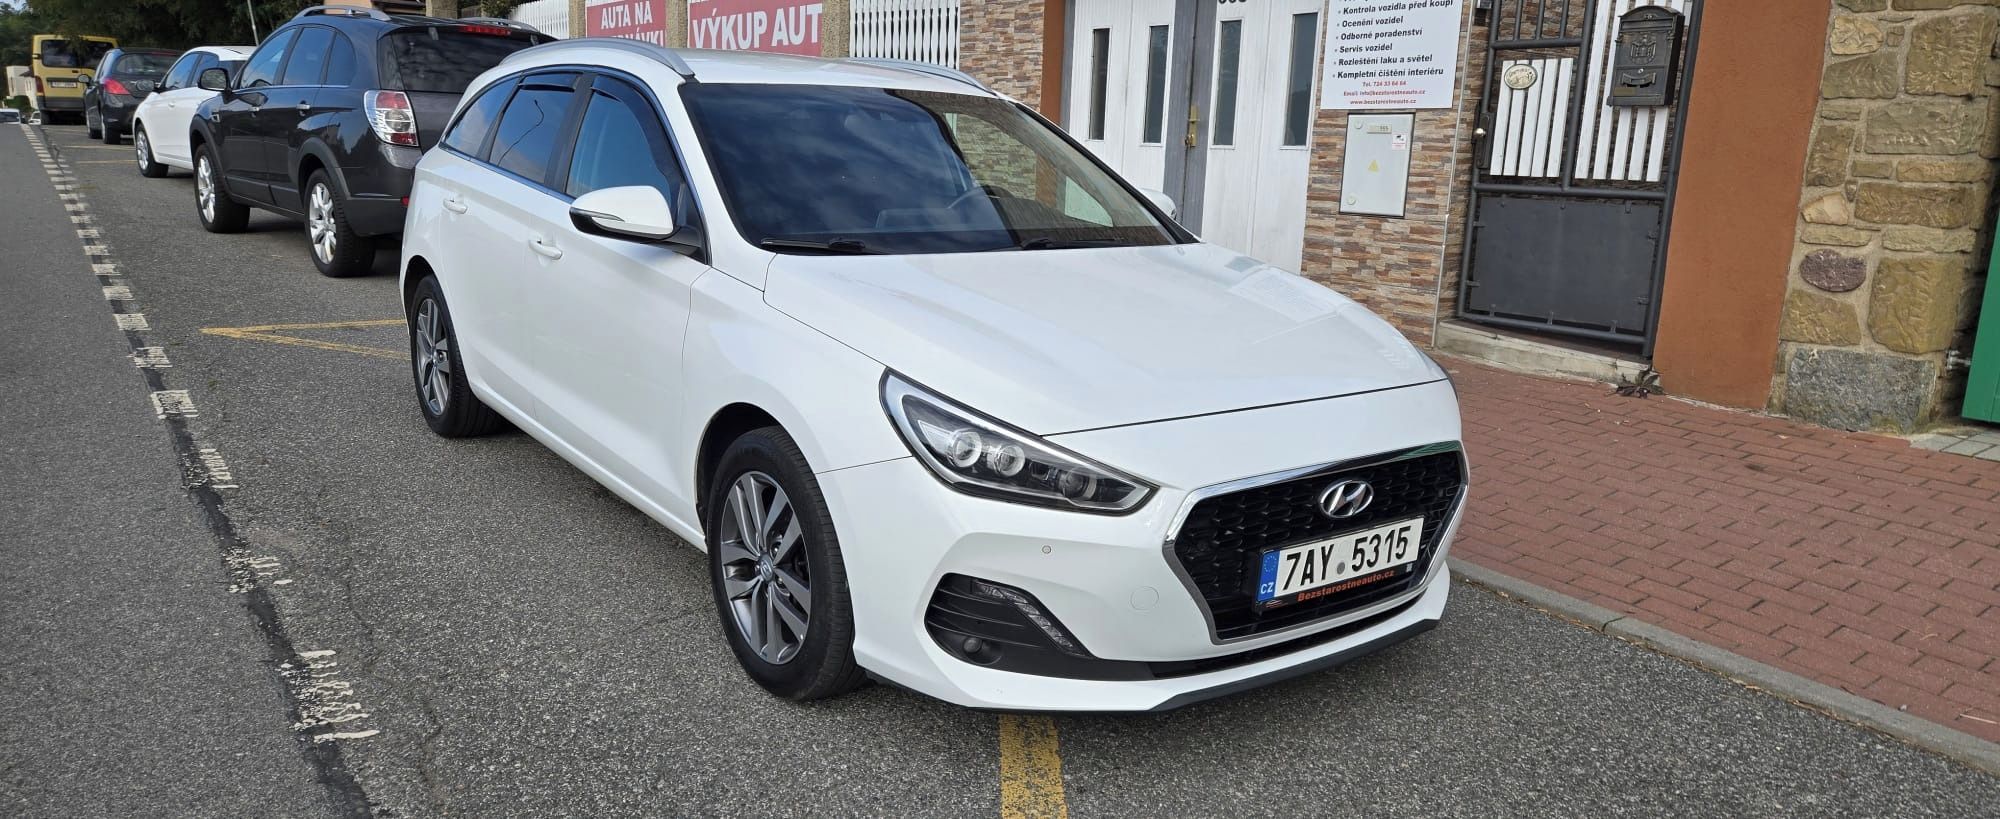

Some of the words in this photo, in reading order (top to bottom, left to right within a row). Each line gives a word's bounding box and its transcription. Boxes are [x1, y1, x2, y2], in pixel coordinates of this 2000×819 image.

[601, 4, 631, 29] AUTA
[635, 1, 652, 25] NA
[1343, 6, 1376, 15] Kontrola
[1378, 3, 1406, 12] vozidla
[1409, 1, 1427, 10] před
[693, 8, 767, 50] VÝKUP
[772, 3, 823, 46] AUT
[1342, 19, 1373, 27] Ocenění
[1376, 16, 1403, 25] vozidel
[1341, 32, 1372, 41] Odborné
[1375, 28, 1423, 39] poradenství
[1339, 45, 1363, 53] Servis
[1365, 43, 1393, 52] vozidel
[1338, 57, 1378, 66] Rozleštění
[1380, 56, 1397, 64] laku
[1407, 54, 1432, 63] světel
[1337, 70, 1376, 80] Kompletní
[1378, 68, 1405, 77] čištění
[1407, 67, 1444, 76] interiéru
[1283, 543, 1335, 590] 7AY
[1351, 525, 1412, 572] 5315
[1260, 581, 1274, 595] CZ
[1297, 569, 1396, 602] Bezstarostneauto.cz
